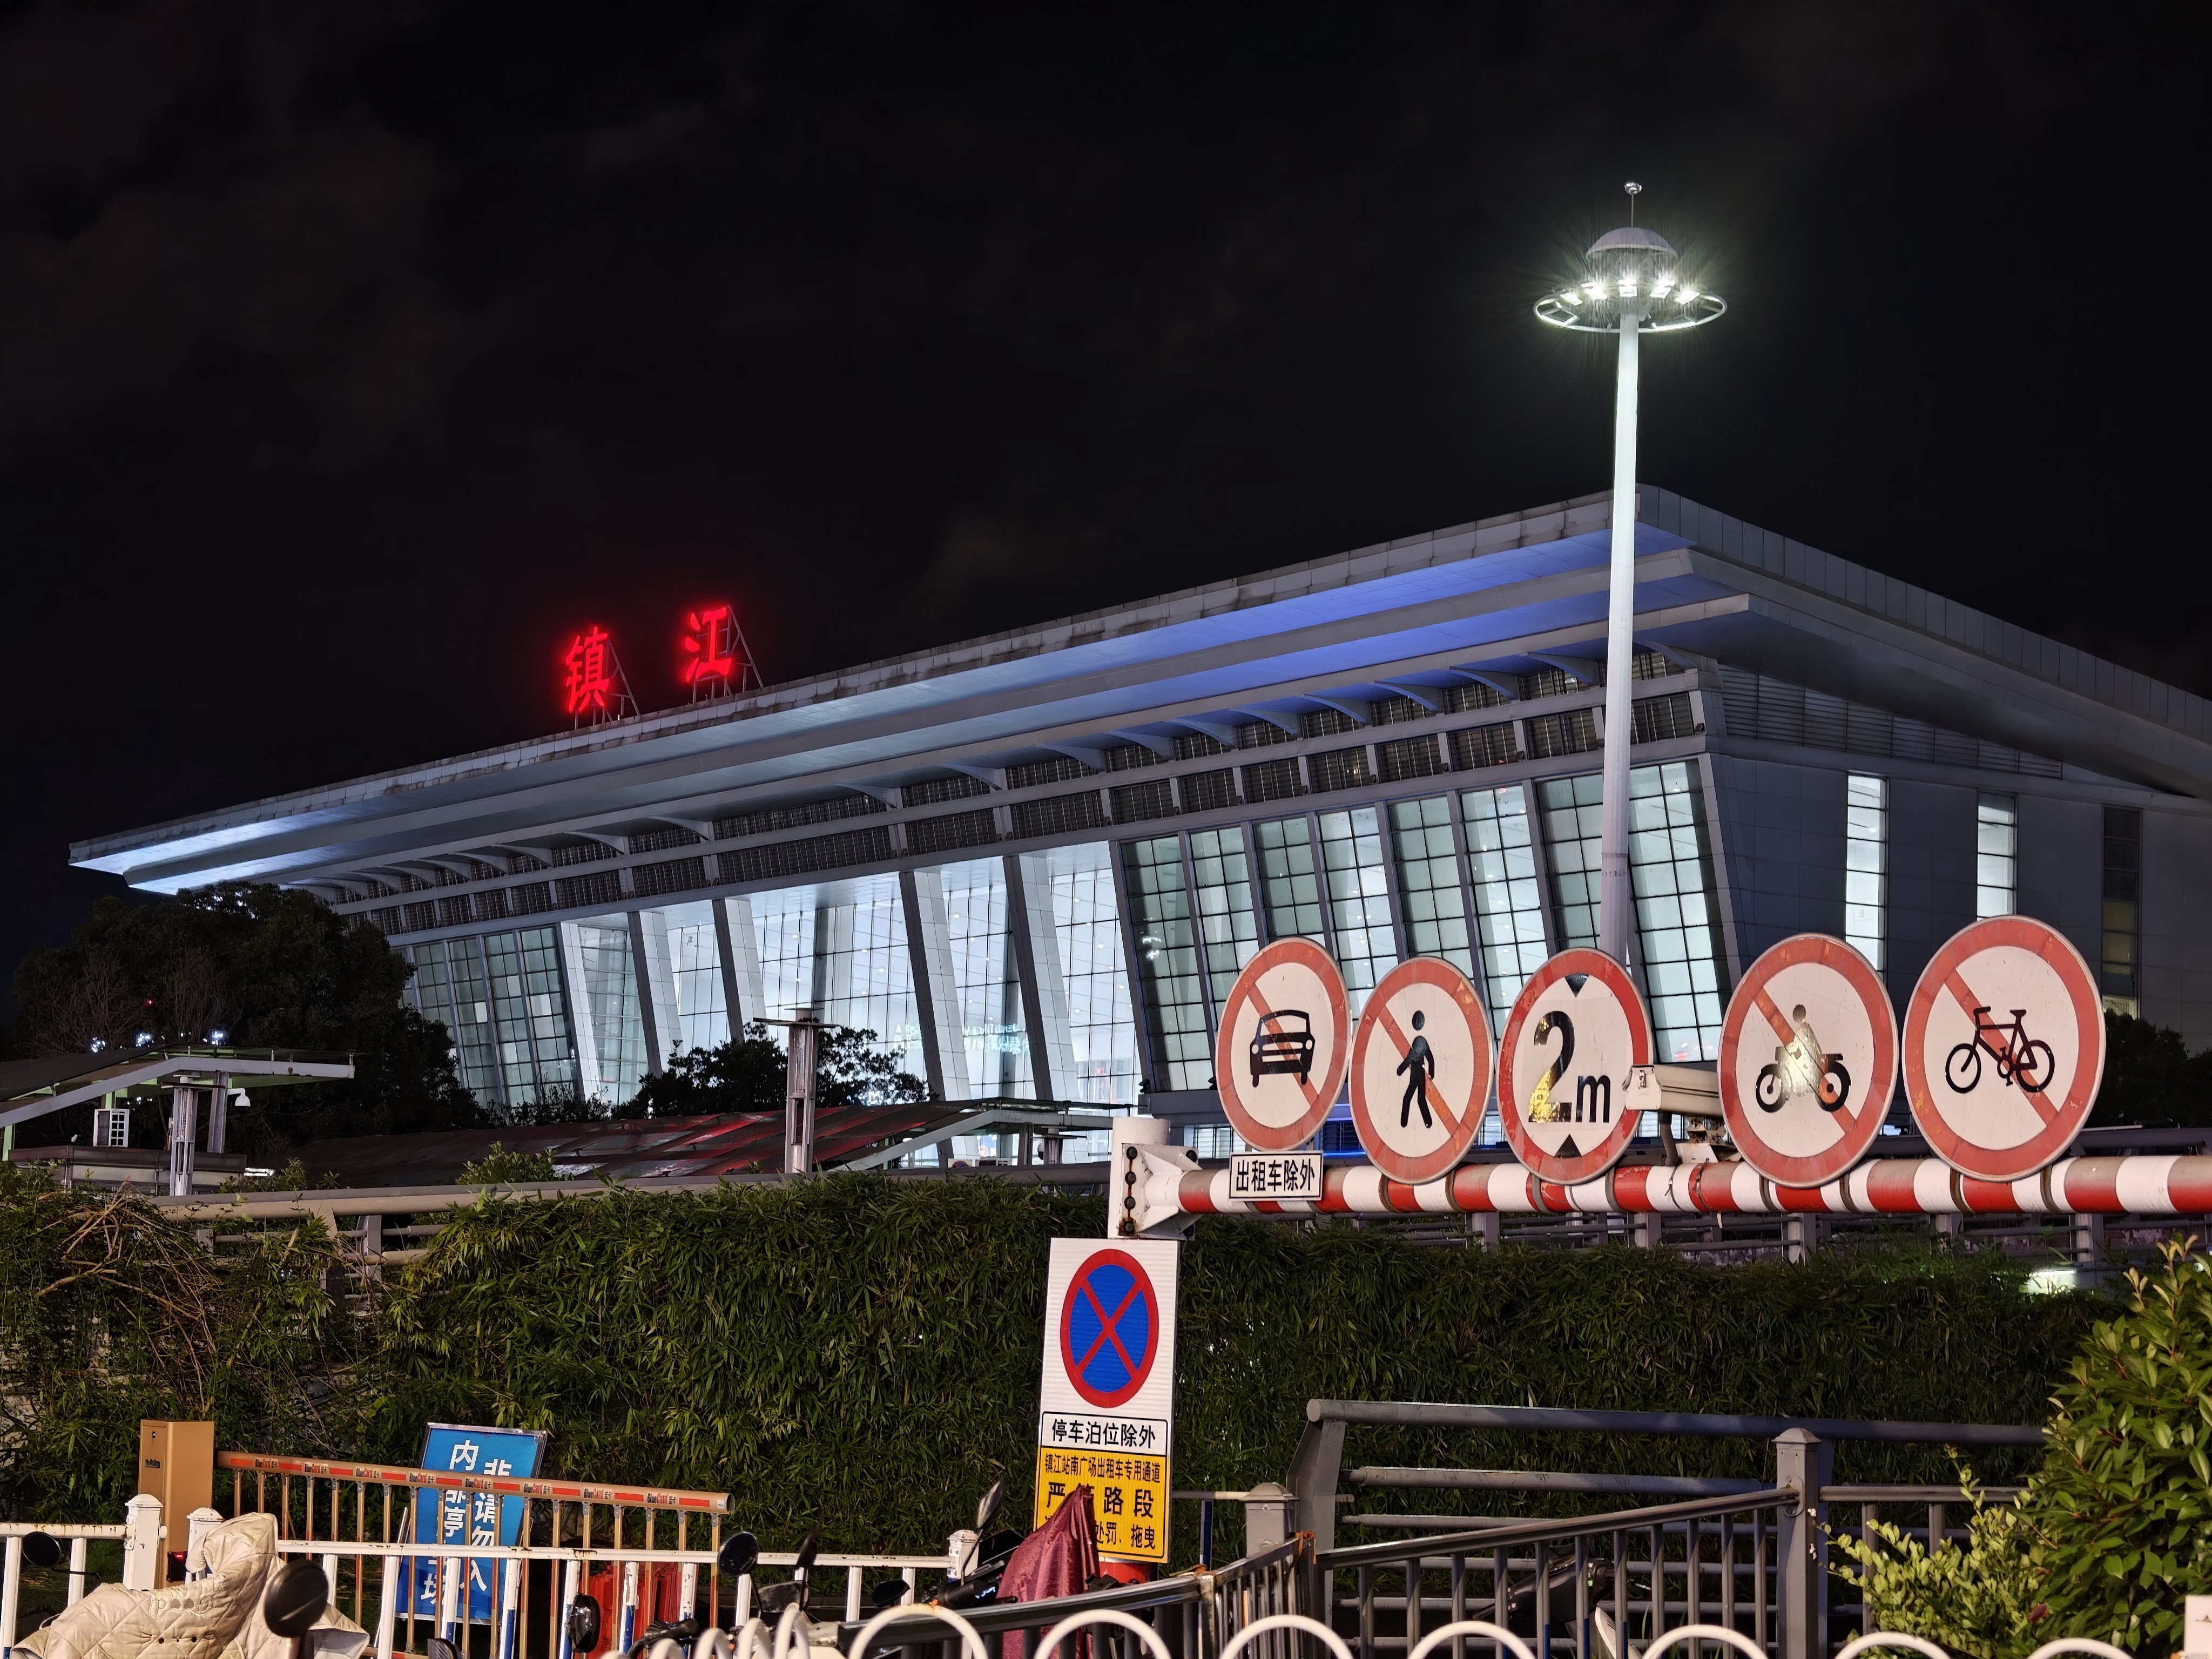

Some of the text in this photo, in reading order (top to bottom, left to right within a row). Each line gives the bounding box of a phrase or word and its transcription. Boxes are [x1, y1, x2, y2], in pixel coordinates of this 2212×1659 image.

[565, 606, 732, 712] 镇江
[1236, 1158, 1315, 1191] 出租车除外
[1052, 1419, 1156, 1448] 停车泊位除外
[1045, 1453, 1161, 1483] 镇江站南广场出租车专用通道
[1046, 1481, 1154, 1519] 严路段
